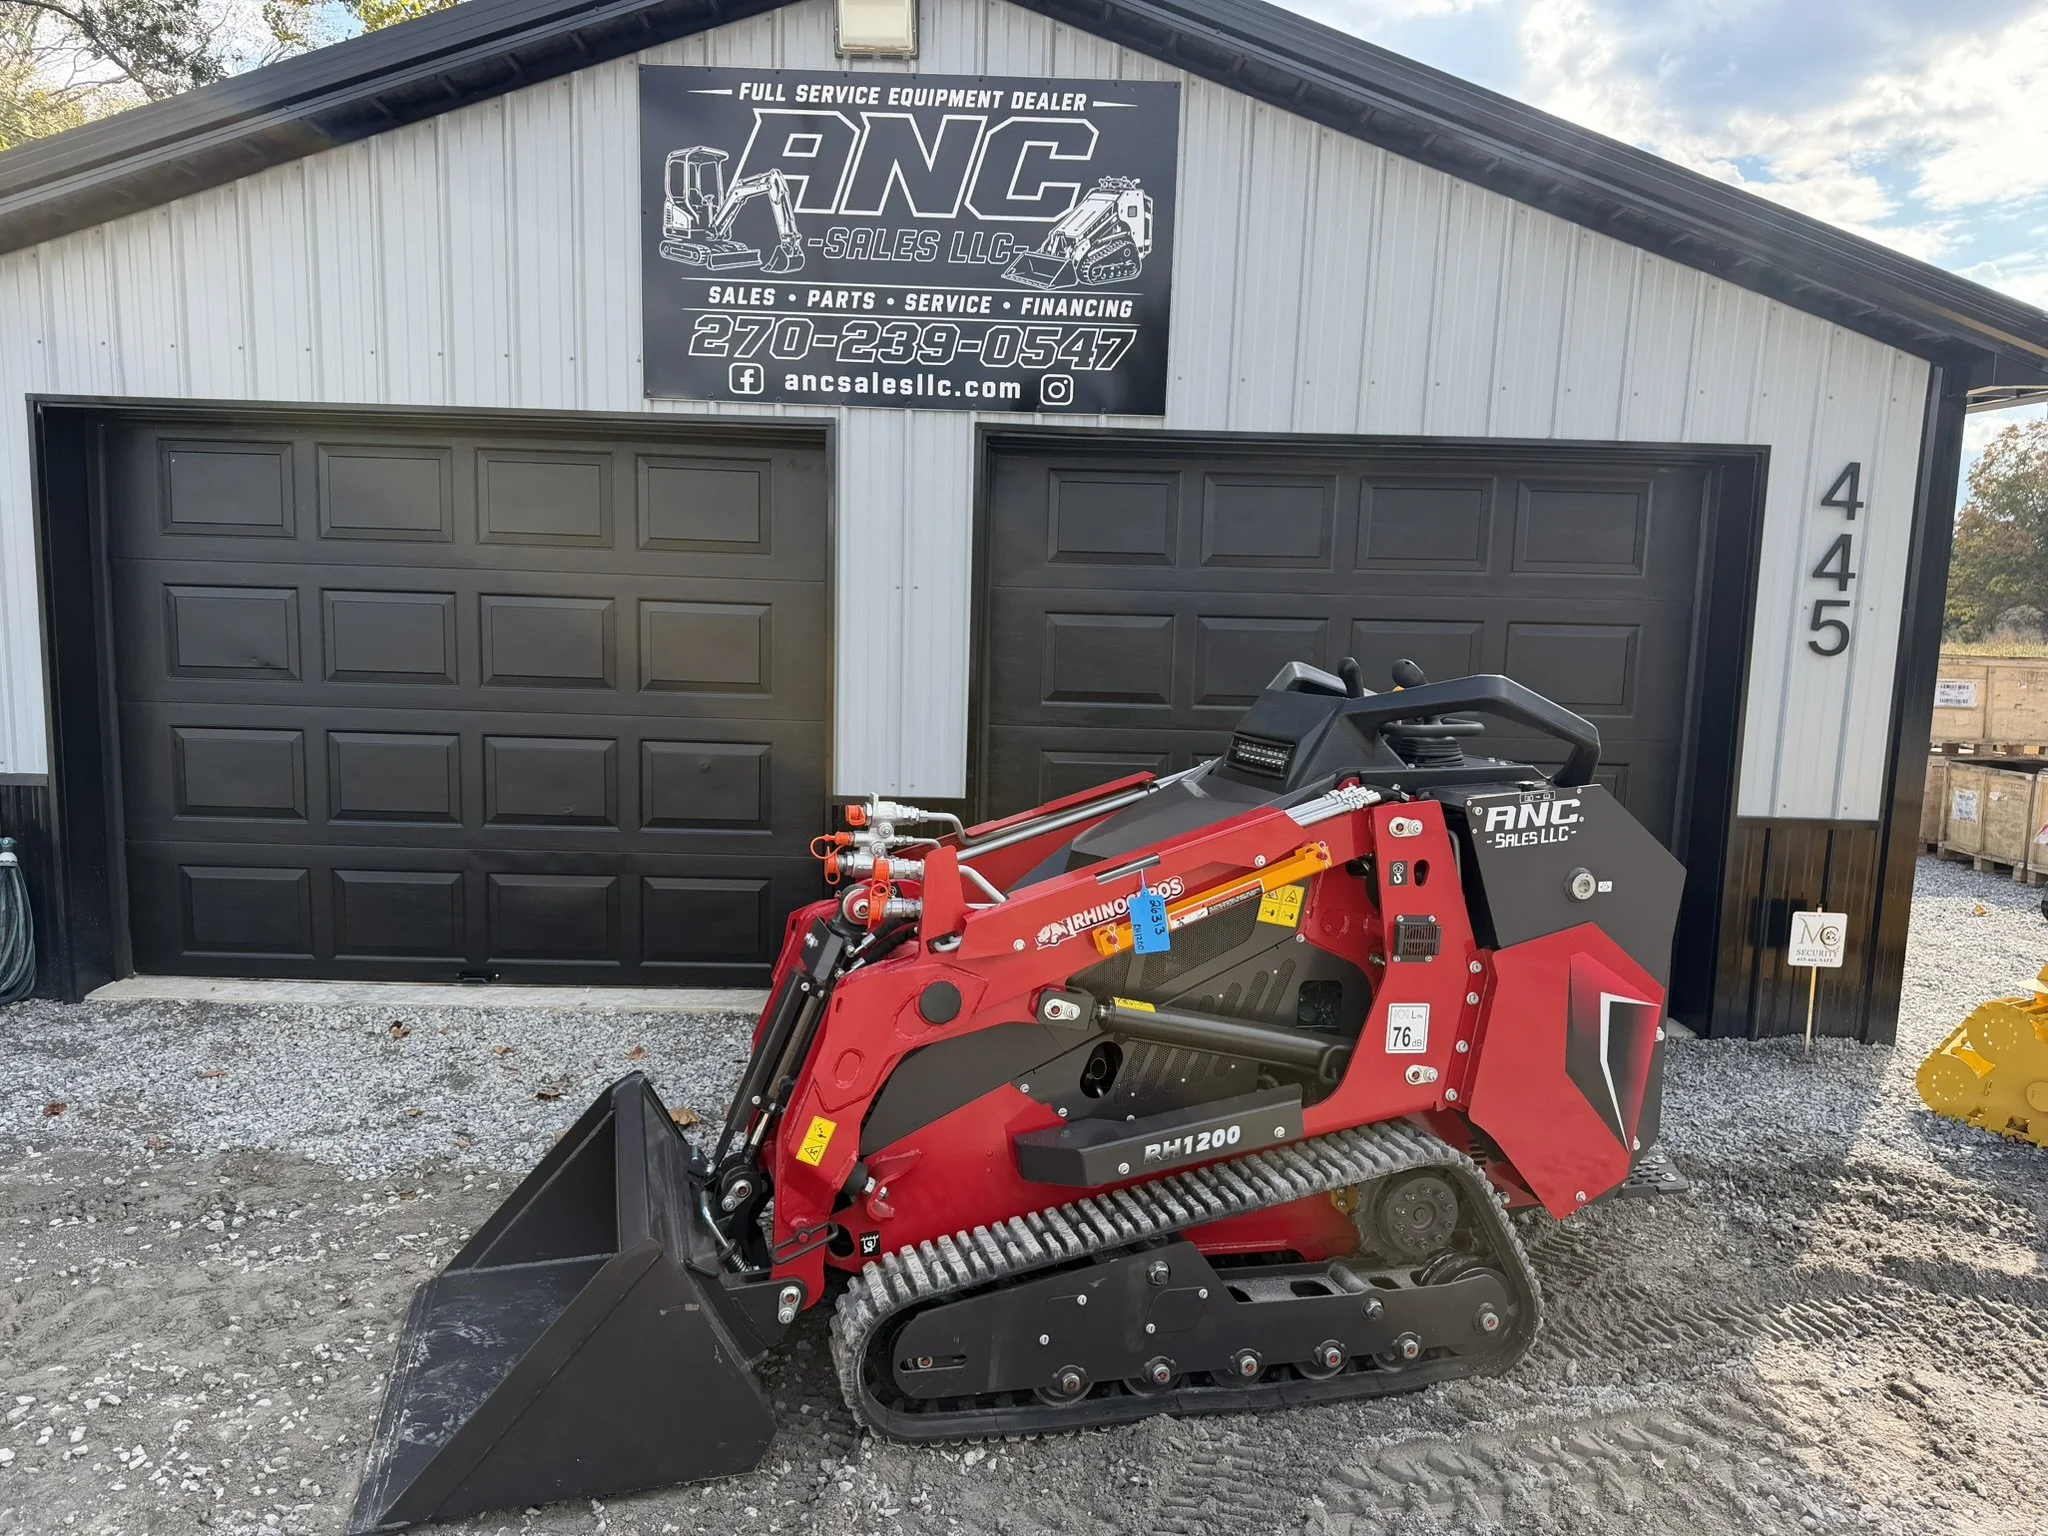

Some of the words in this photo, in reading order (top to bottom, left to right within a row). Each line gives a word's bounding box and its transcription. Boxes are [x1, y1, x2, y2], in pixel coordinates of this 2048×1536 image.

[739, 82, 786, 102] FULL
[795, 84, 881, 105] SERVICE
[888, 87, 1003, 109] EQUIPMENT
[1010, 92, 1087, 112] DEALER
[725, 107, 1099, 222] ANC
[708, 286, 776, 306] SALES
[807, 290, 875, 311] PARTS
[904, 294, 993, 315] SERVICE
[1020, 297, 1133, 319] FINANCING
[688, 314, 1137, 371] 270-239-0547
[784, 372, 1021, 399] ancsalesllc.com
[1485, 798, 1581, 832] ANC
[1073, 876, 1184, 931] RHINOROS
[1796, 949, 1839, 957] SECURITY
[1393, 1026, 1411, 1047] 76
[1411, 1038, 1423, 1047] dB
[1143, 1125, 1241, 1166] RH1200
